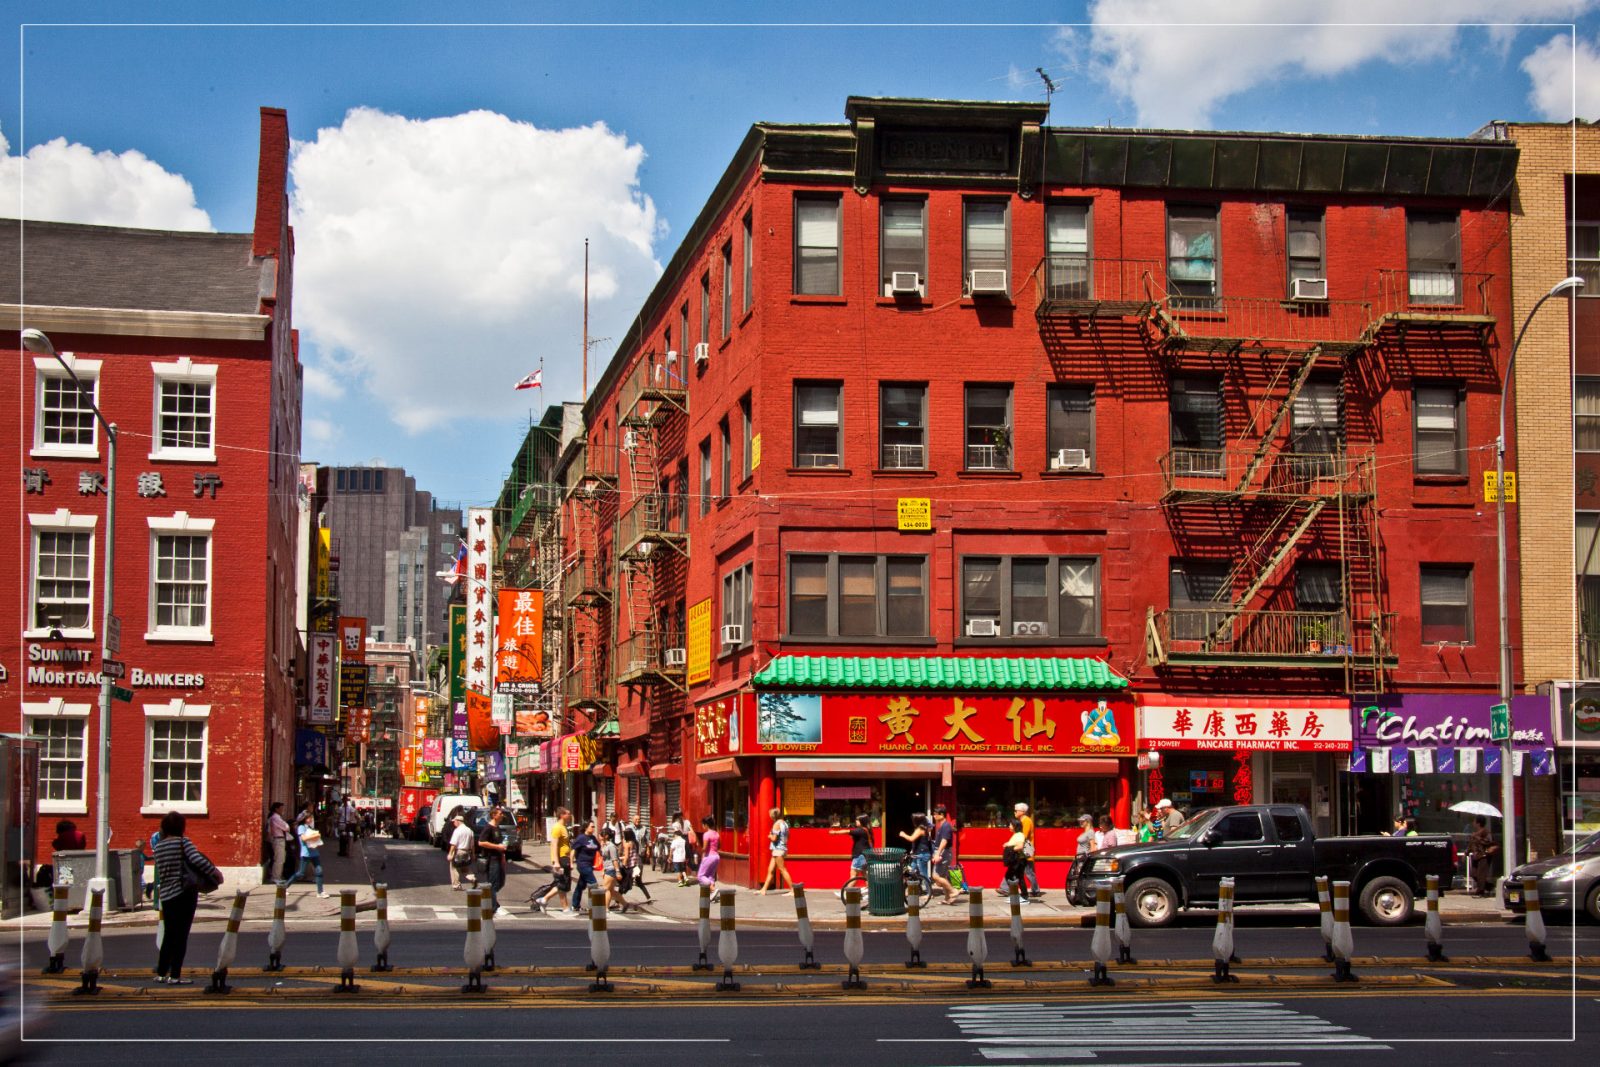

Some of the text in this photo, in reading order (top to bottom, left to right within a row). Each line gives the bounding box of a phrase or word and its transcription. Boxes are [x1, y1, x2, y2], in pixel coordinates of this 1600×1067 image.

[513, 592, 536, 636] 最佳
[28, 643, 92, 662] SUMMIT
[28, 667, 116, 686] MORTGAG
[131, 668, 204, 687] BANKERS
[878, 696, 1057, 744] 黃大仙
[1172, 708, 1325, 738] 華康西藥房
[1377, 715, 1492, 741] Chatim
[1037, 744, 1055, 752] INC.
[1197, 739, 1300, 750] PANCARE PHARMACY INC.
